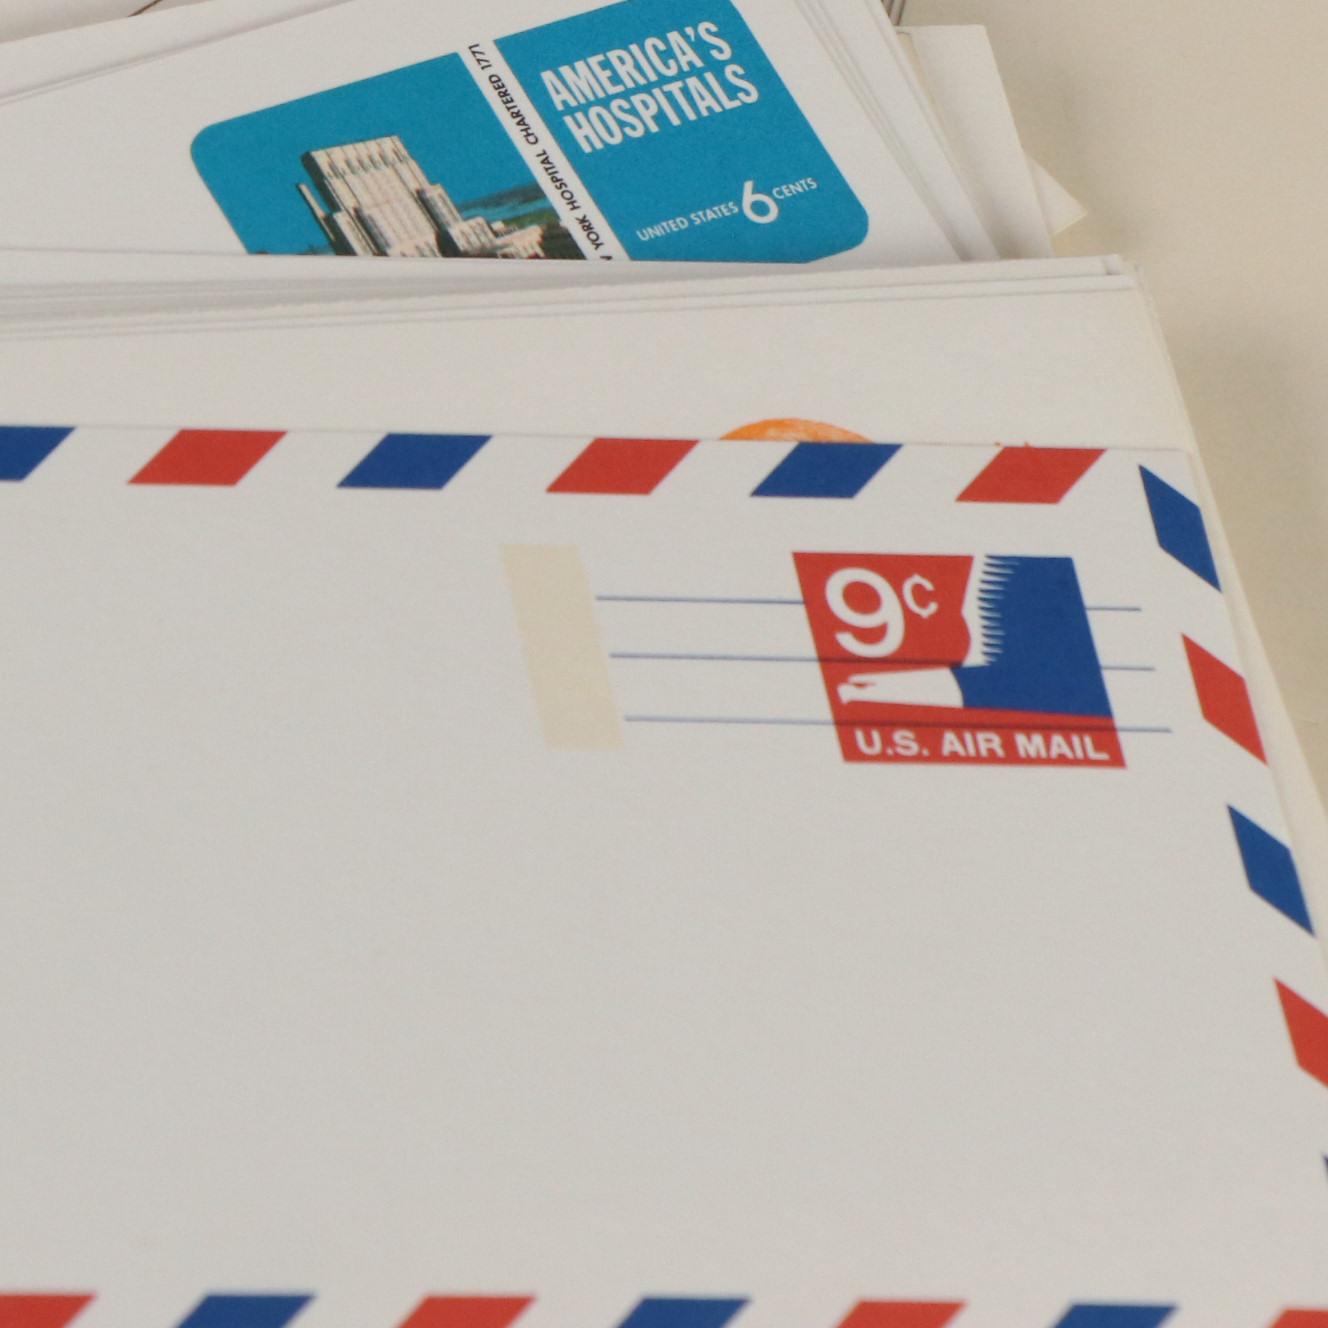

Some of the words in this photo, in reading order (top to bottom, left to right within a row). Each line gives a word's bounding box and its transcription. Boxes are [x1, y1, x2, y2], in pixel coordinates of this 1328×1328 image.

[469, 43, 492, 71] 1771
[540, 21, 733, 111] AMERICA'S
[488, 74, 539, 146] CHARTERED
[562, 64, 759, 153] HOSPITALS
[536, 149, 581, 211] HOSPITAL
[636, 217, 689, 241] UNITED
[690, 201, 739, 225] STATES
[742, 180, 779, 224] 6
[772, 177, 818, 199] CENTS
[575, 214, 604, 251] YORK
[854, 728, 929, 757] U.S.
[941, 731, 1004, 758] AIR
[1014, 733, 1110, 760] MAIL
